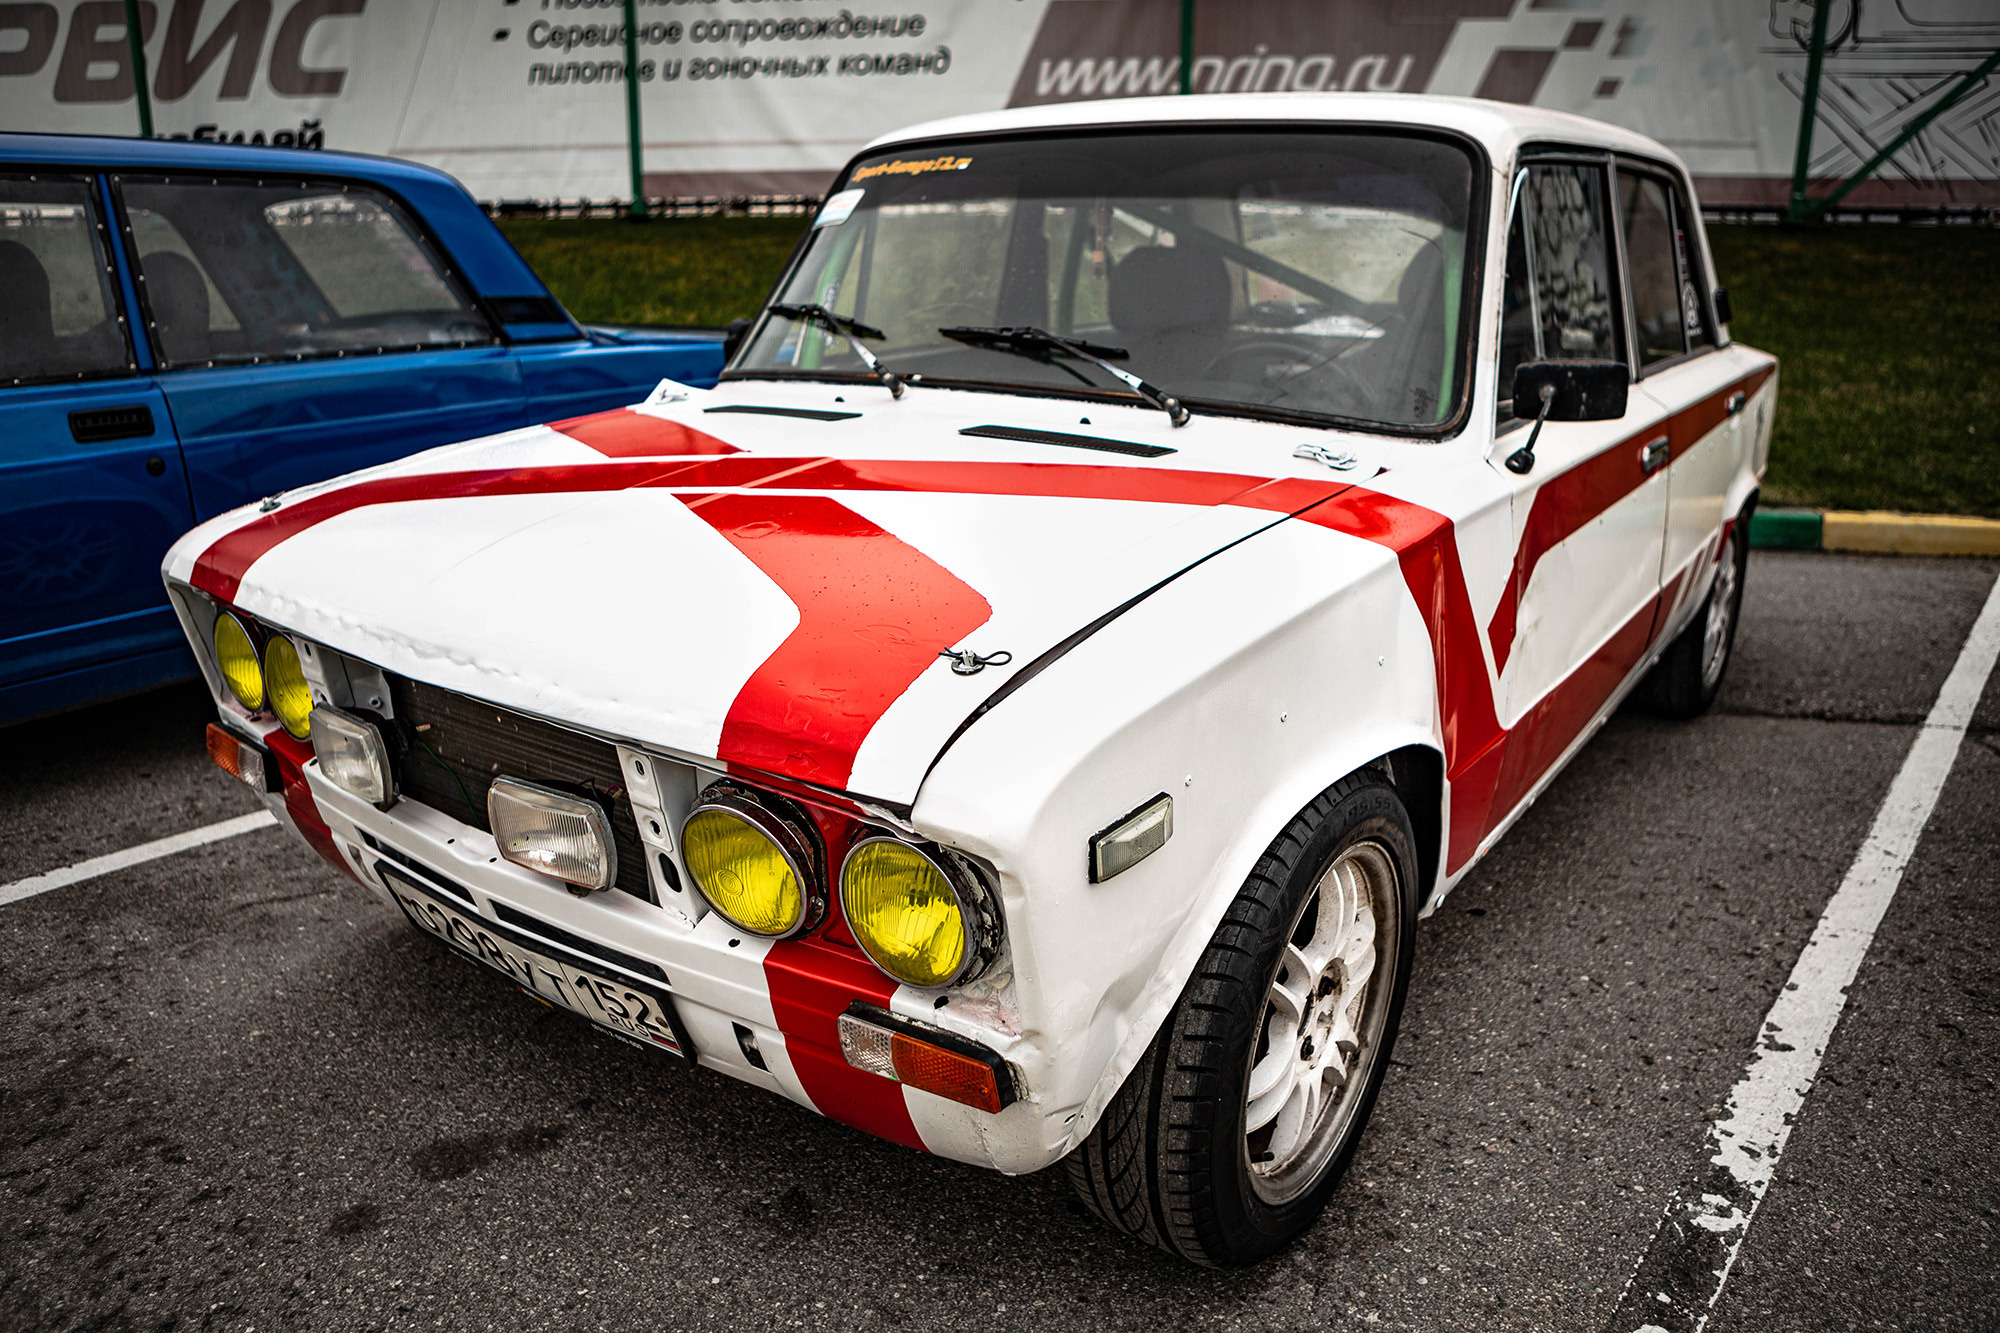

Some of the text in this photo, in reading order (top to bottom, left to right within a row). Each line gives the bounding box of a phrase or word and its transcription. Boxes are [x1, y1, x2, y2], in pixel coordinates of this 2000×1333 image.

[689, 9, 926, 47] сопровождение
[661, 57, 682, 82] и
[687, 55, 829, 81] гоночных
[836, 45, 952, 77] команд
[574, 974, 661, 1033] 152
[606, 1012, 650, 1038] RUS
